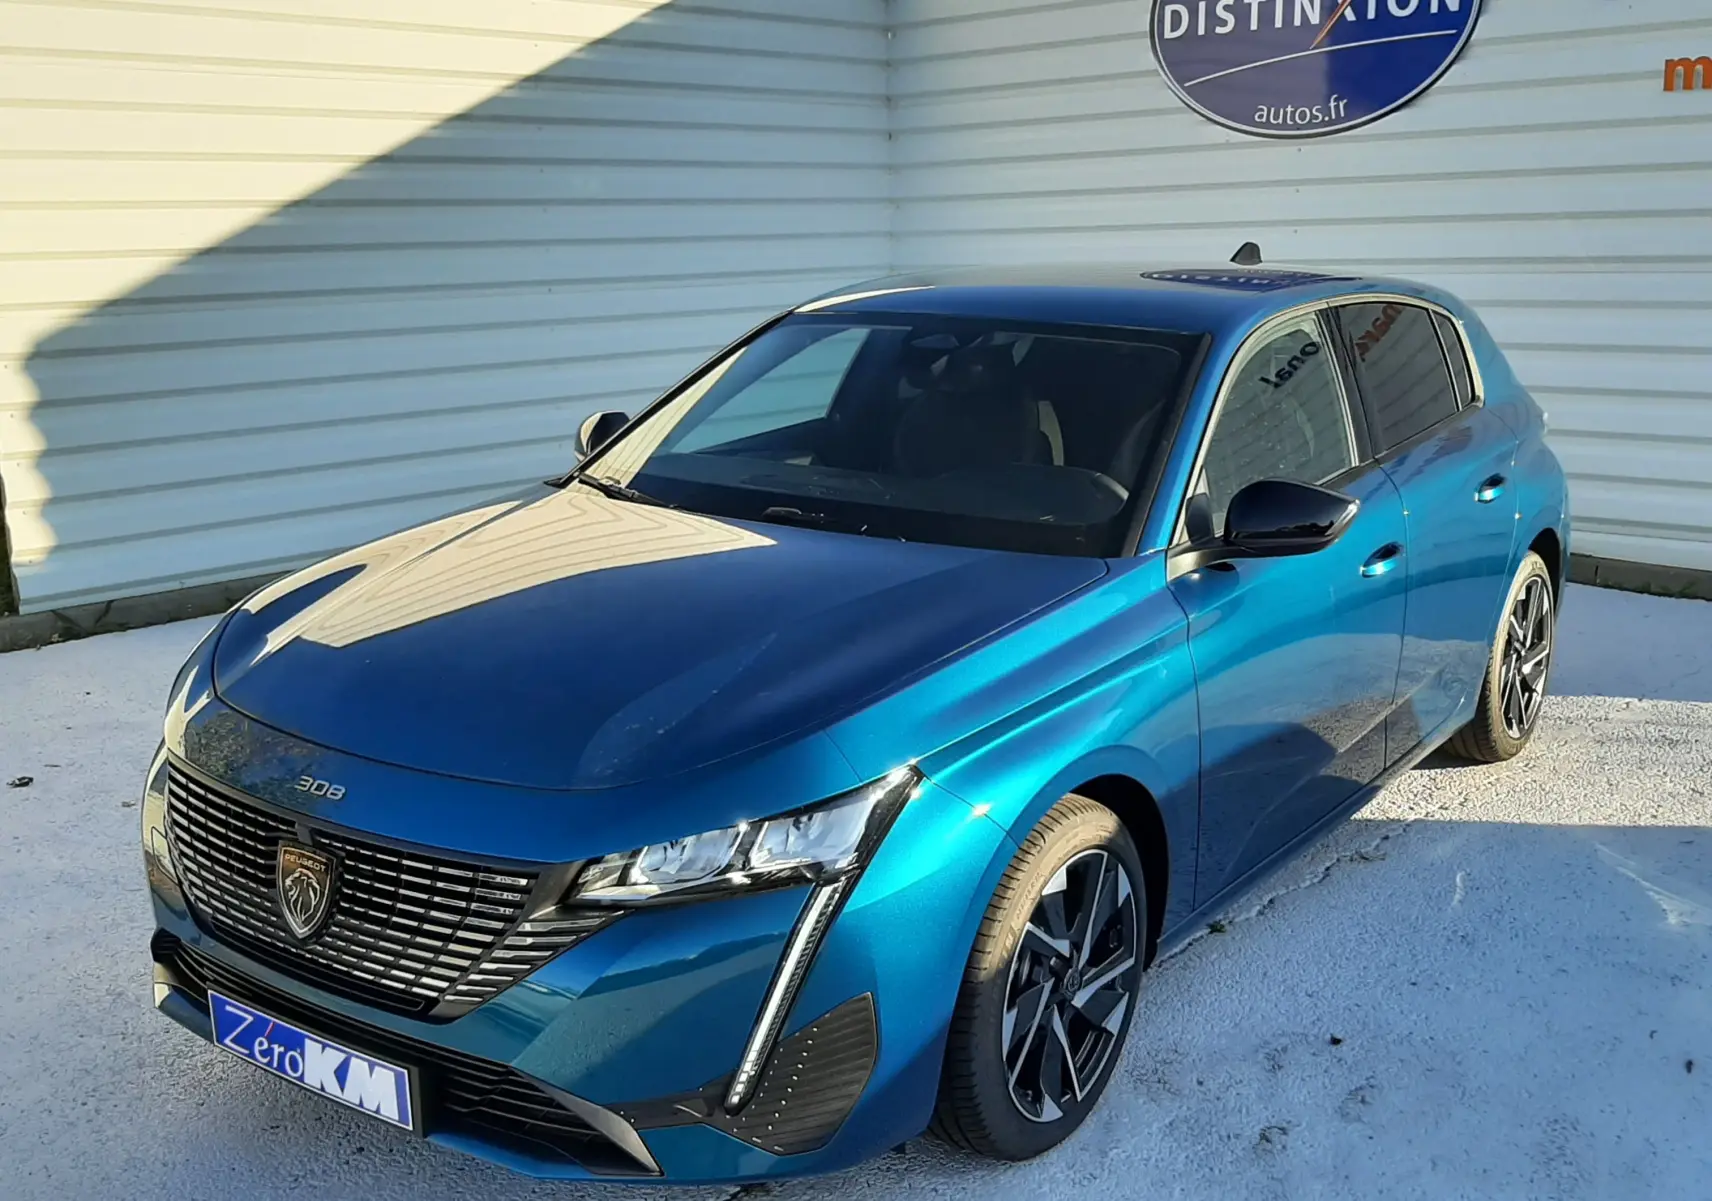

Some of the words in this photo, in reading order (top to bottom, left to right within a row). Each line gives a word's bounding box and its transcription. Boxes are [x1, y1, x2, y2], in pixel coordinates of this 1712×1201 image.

[1254, 94, 1348, 125] autos.fr
[294, 775, 346, 801] 308
[284, 853, 327, 873] PEUGEOT
